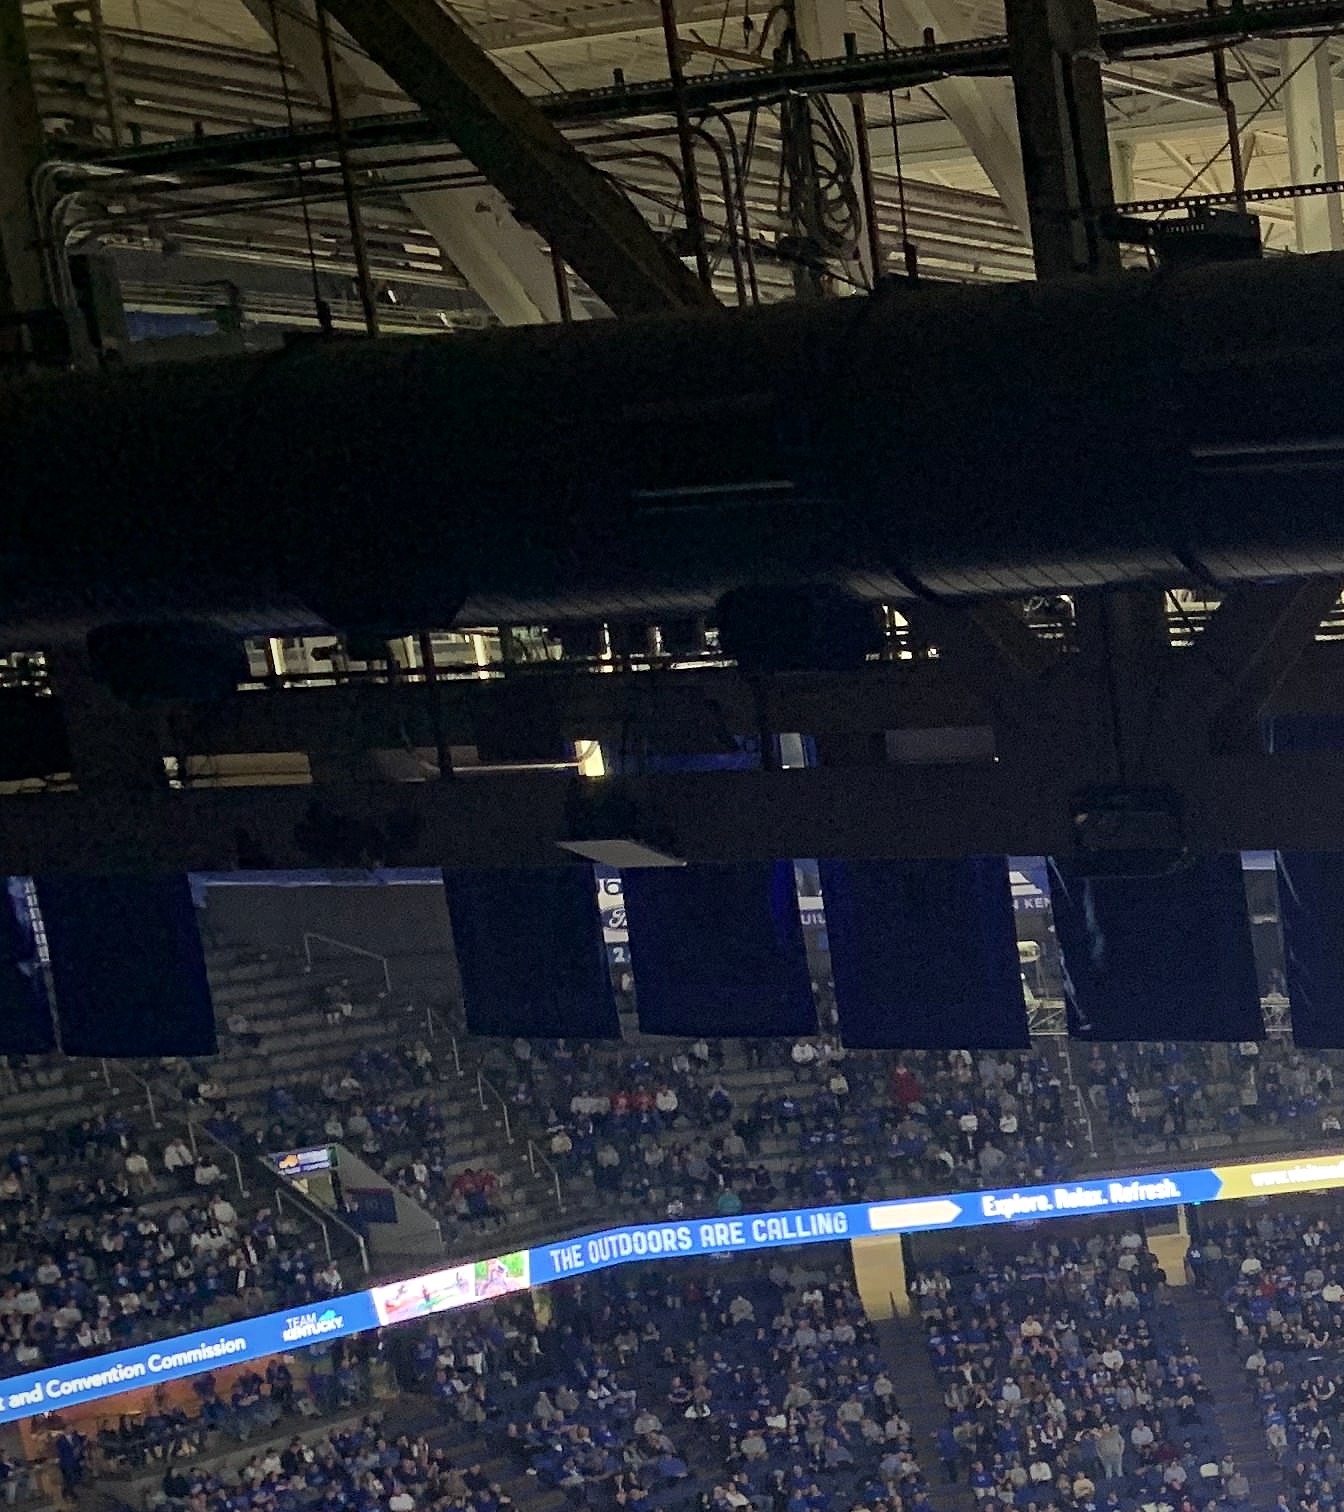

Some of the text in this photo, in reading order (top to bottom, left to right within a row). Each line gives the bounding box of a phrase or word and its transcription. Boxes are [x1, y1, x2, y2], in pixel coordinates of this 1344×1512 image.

[550, 1211, 848, 1273] THE OUTDOORS ARE CALLING
[286, 1312, 317, 1329] TEAM
[9, 1336, 247, 1410] and Convention Commission
